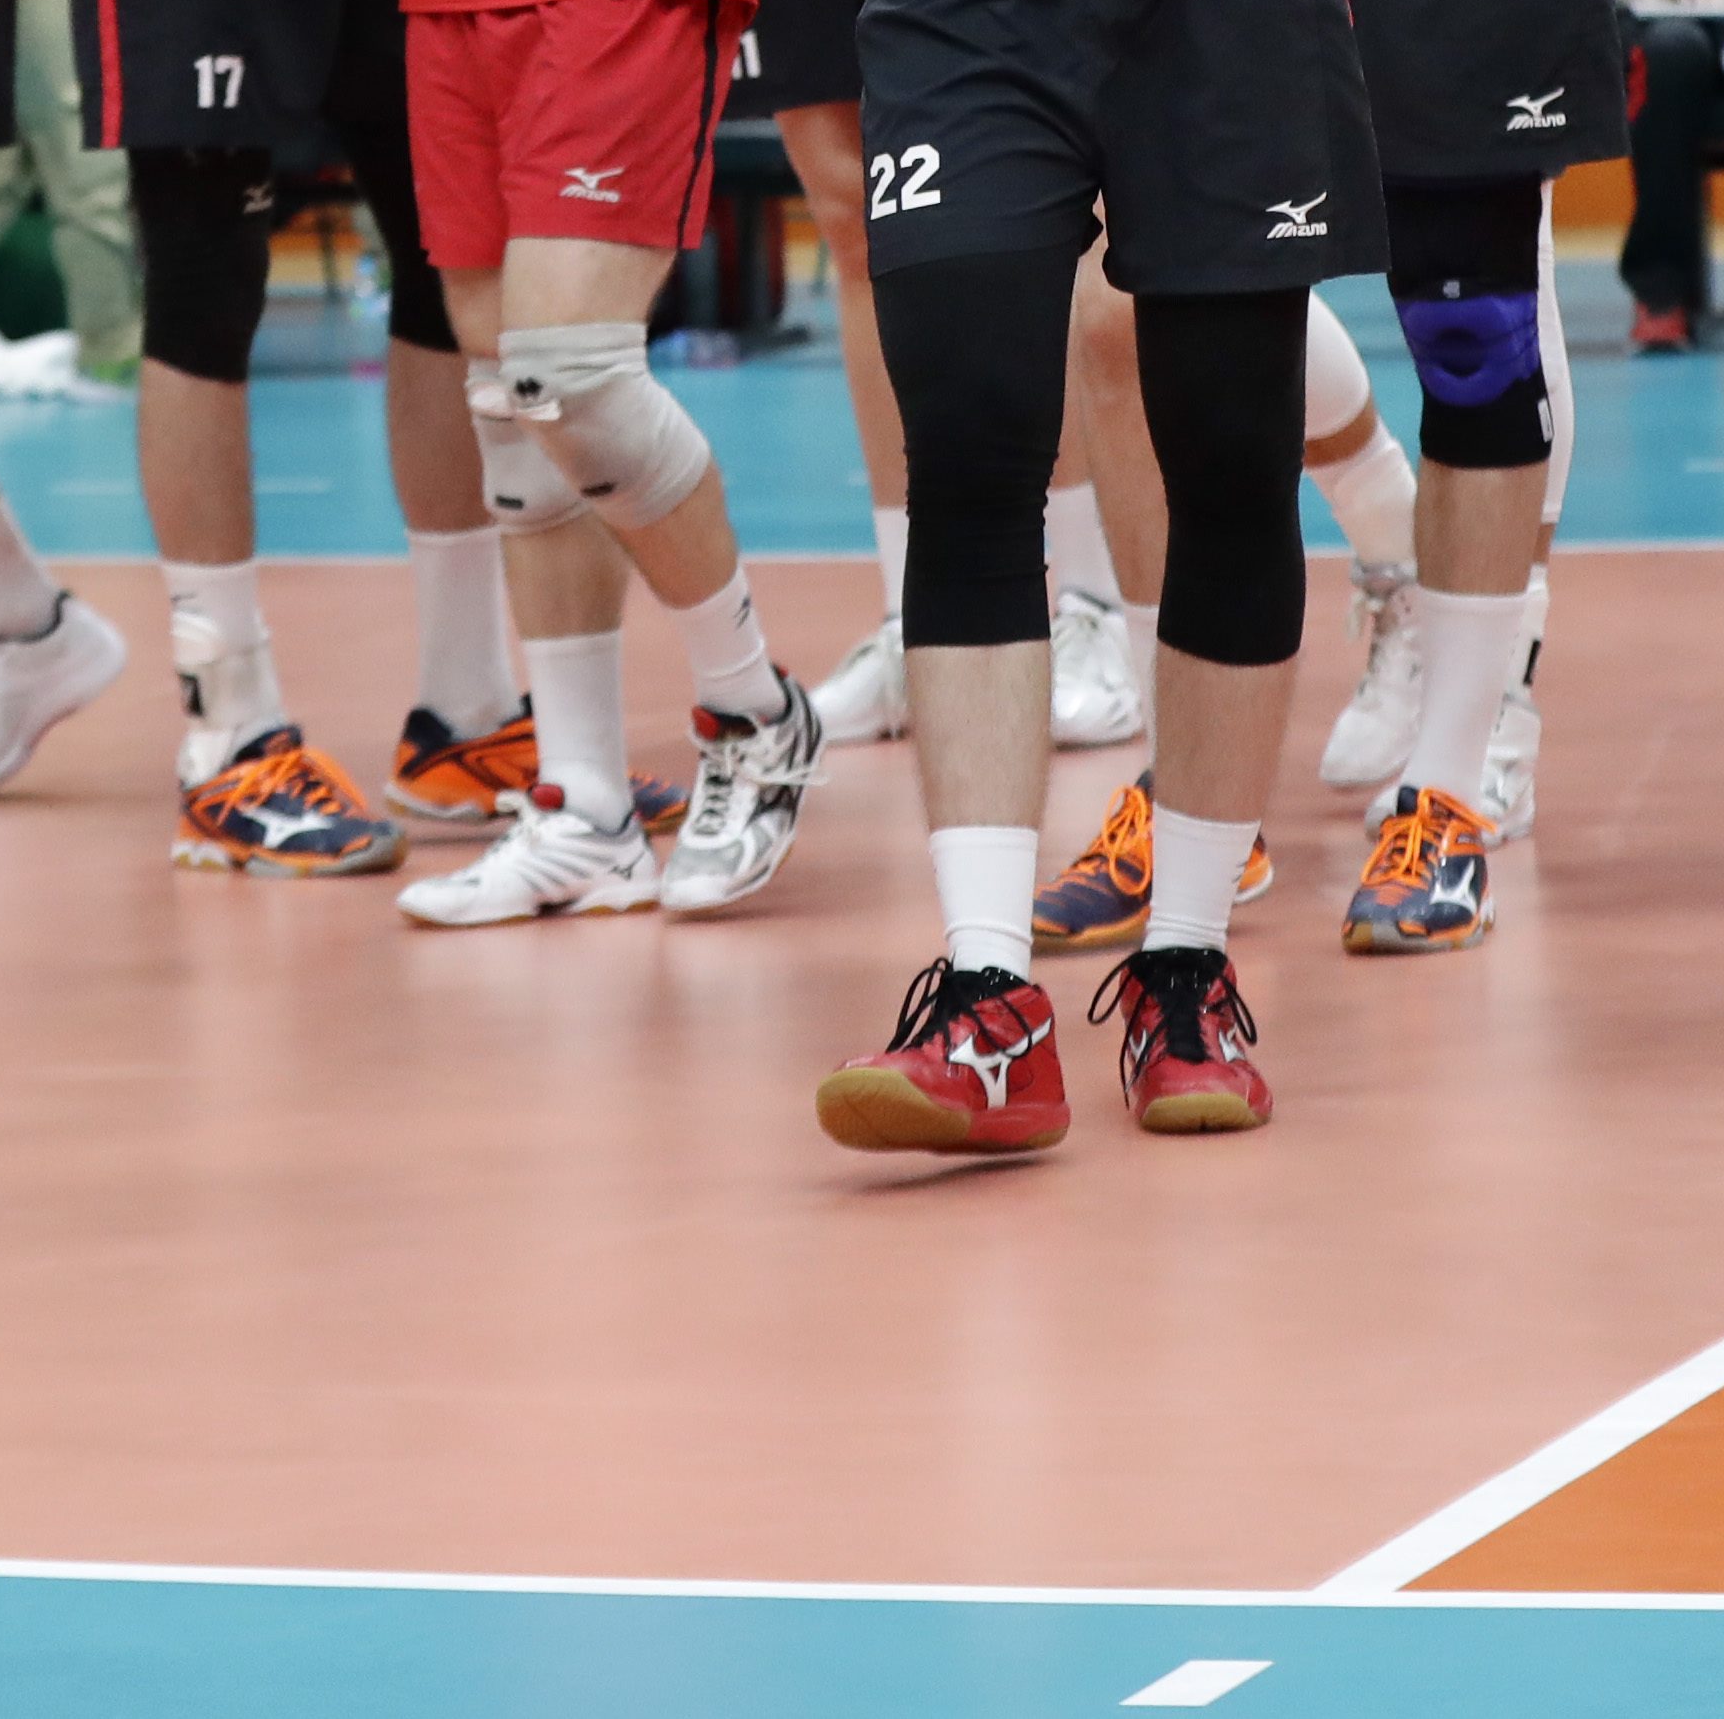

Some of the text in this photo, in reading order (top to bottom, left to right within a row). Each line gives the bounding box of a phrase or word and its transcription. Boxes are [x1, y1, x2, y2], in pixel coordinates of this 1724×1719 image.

[194, 54, 245, 108] 17
[870, 144, 941, 220] 22
[1266, 222, 1328, 240] MIZUNO
